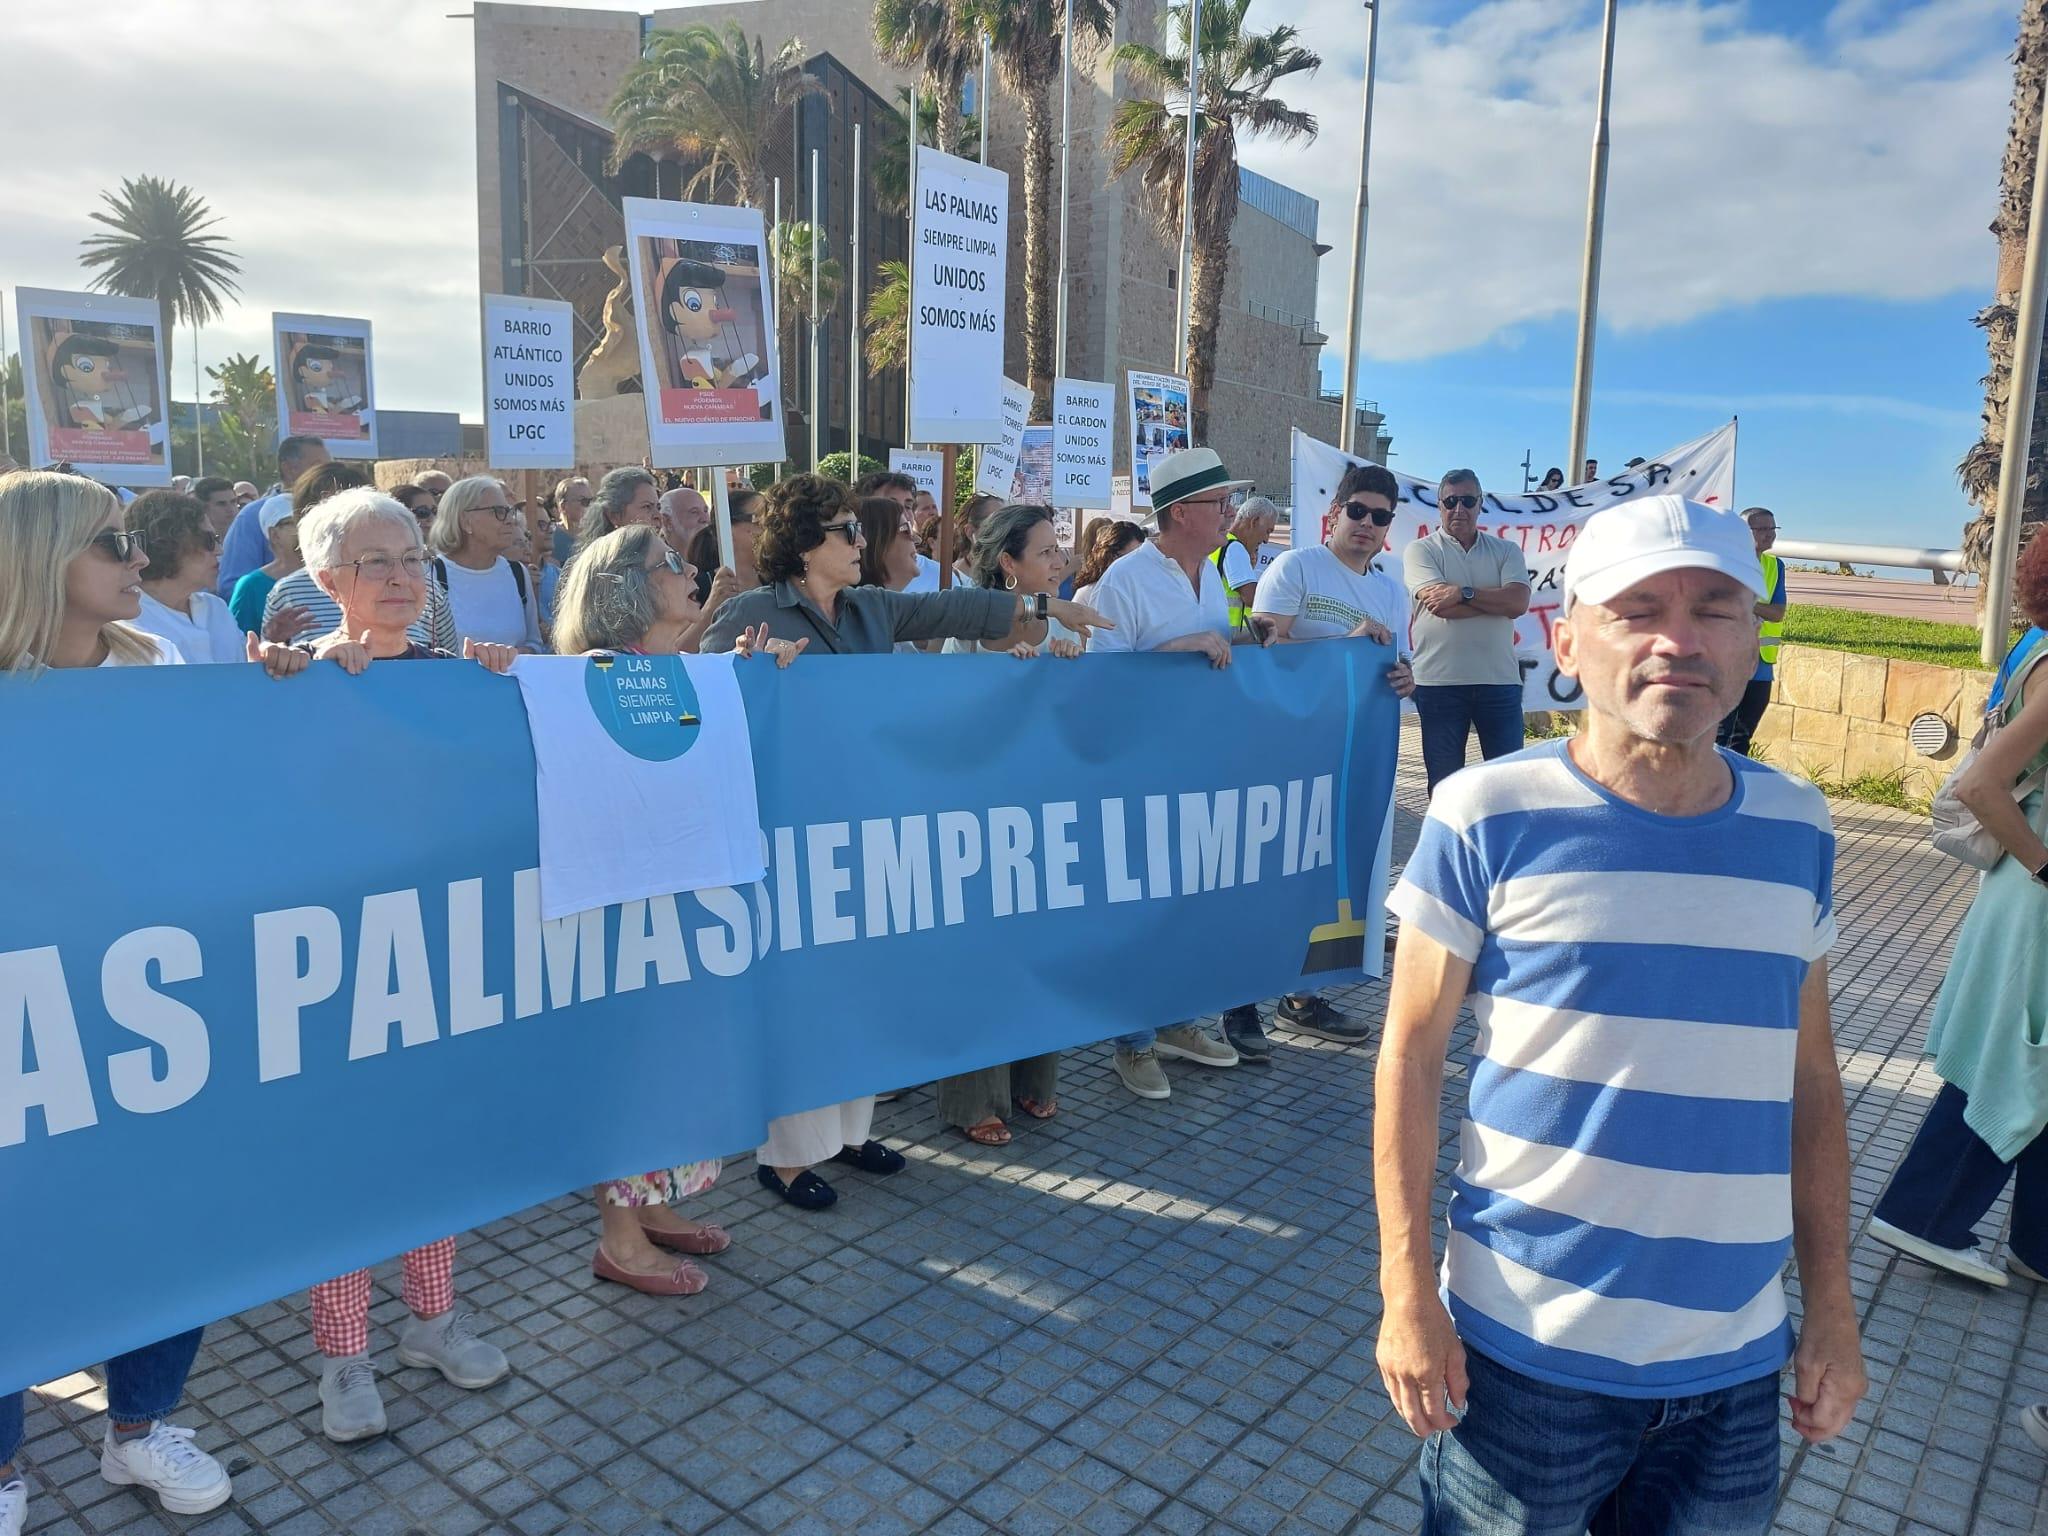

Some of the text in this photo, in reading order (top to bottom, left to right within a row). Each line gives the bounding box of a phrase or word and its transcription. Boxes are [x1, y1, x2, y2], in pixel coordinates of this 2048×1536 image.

[925, 188, 998, 225] LAS PALMAS
[923, 228, 997, 257] SIEMPRE LIMPIA
[934, 263, 986, 292] UNIDOS
[920, 305, 996, 333] SOMOS MÁS
[504, 319, 552, 336] BARRIO
[494, 344, 563, 363] ATLÁNTICO
[505, 373, 554, 388] UNIDOS
[494, 397, 565, 412] SOMOS MÁS
[1066, 395, 1099, 409] BARRIO
[1058, 414, 1107, 429] EL CARDON
[509, 424, 546, 440] LPGC
[1065, 434, 1099, 447] UNIDOS
[1056, 453, 1106, 465] SOMOS MÁS
[901, 462, 932, 472] BARRIO
[987, 463, 1003, 479] LPGC
[1065, 473, 1091, 485] LPGC
[627, 659, 652, 672] LAS
[616, 677, 667, 690] PALMAS
[618, 694, 676, 708] SIEMPRE
[630, 710, 675, 725] LIMPIA
[253, 867, 753, 1083] PALMAS
[1100, 773, 1334, 904] LIMPIA
